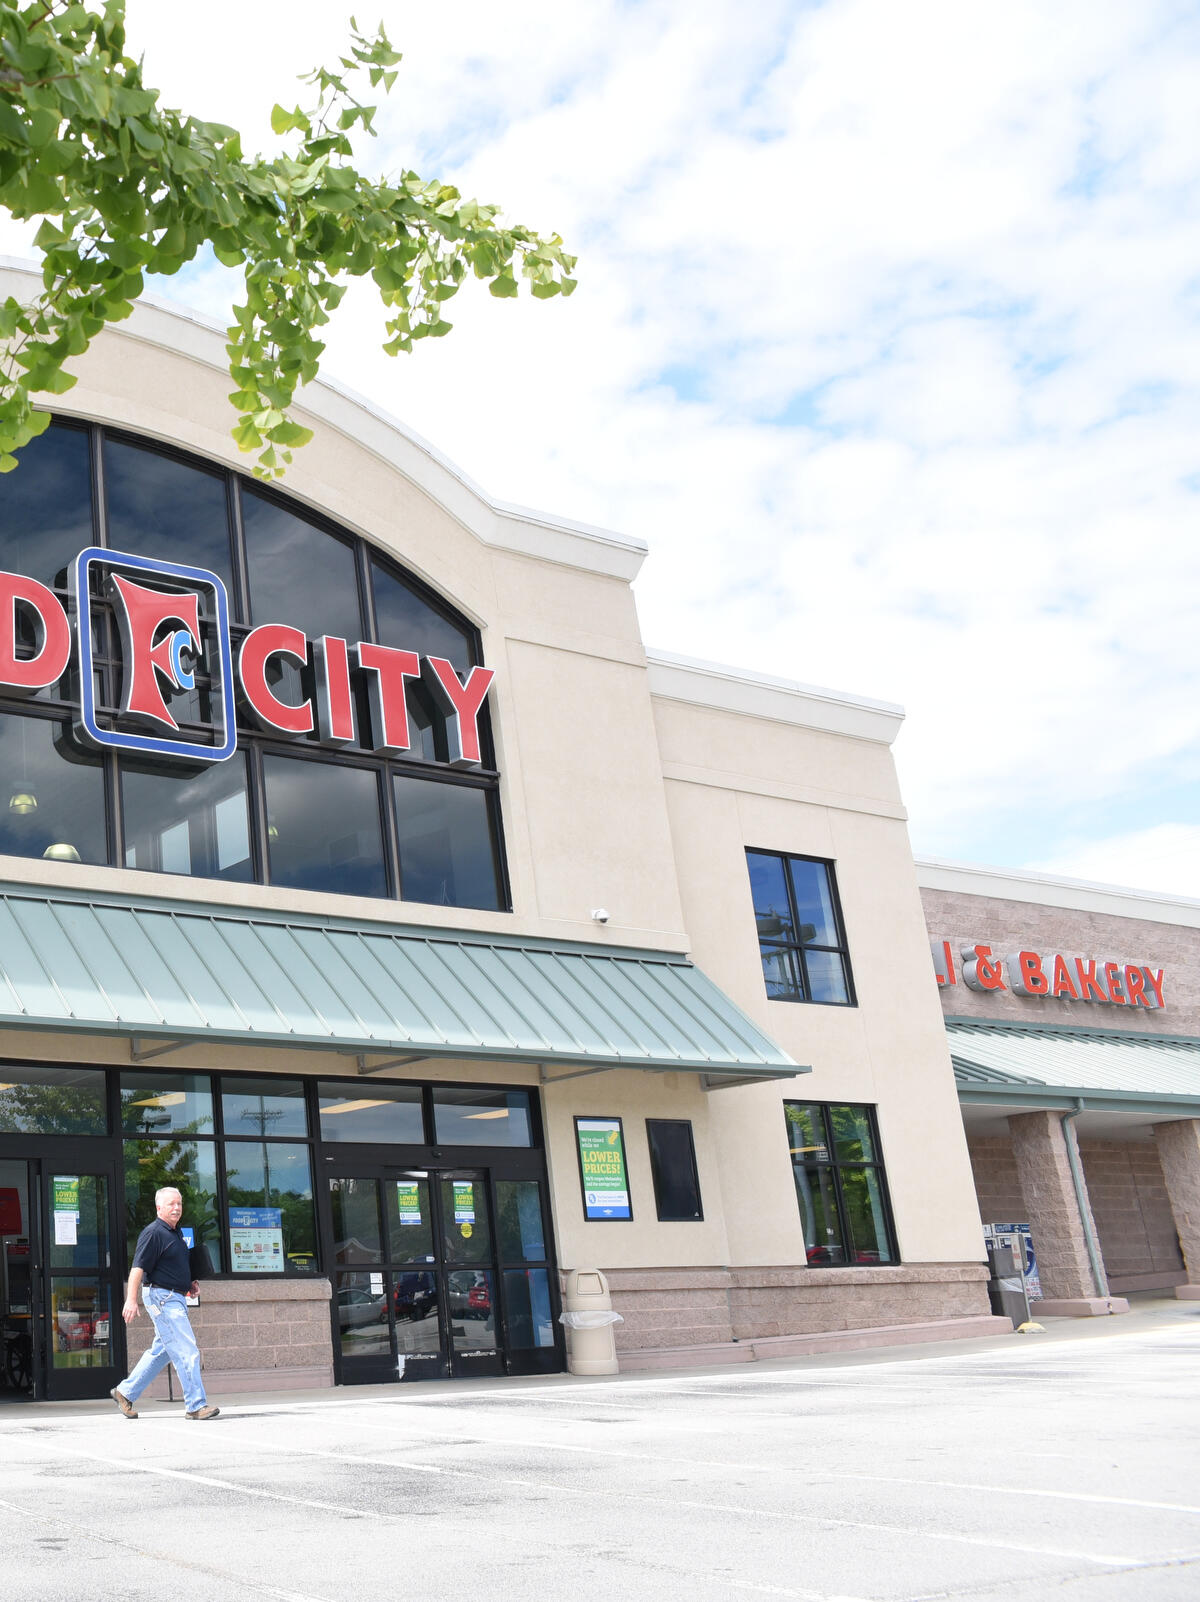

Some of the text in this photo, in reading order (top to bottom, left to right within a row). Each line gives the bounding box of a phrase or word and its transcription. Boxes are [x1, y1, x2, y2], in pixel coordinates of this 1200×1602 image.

[238, 624, 496, 768] CITY
[1017, 951, 1165, 1008] BAKERY
[583, 1151, 621, 1163] LOWER
[584, 1163, 621, 1174] PRICES!
